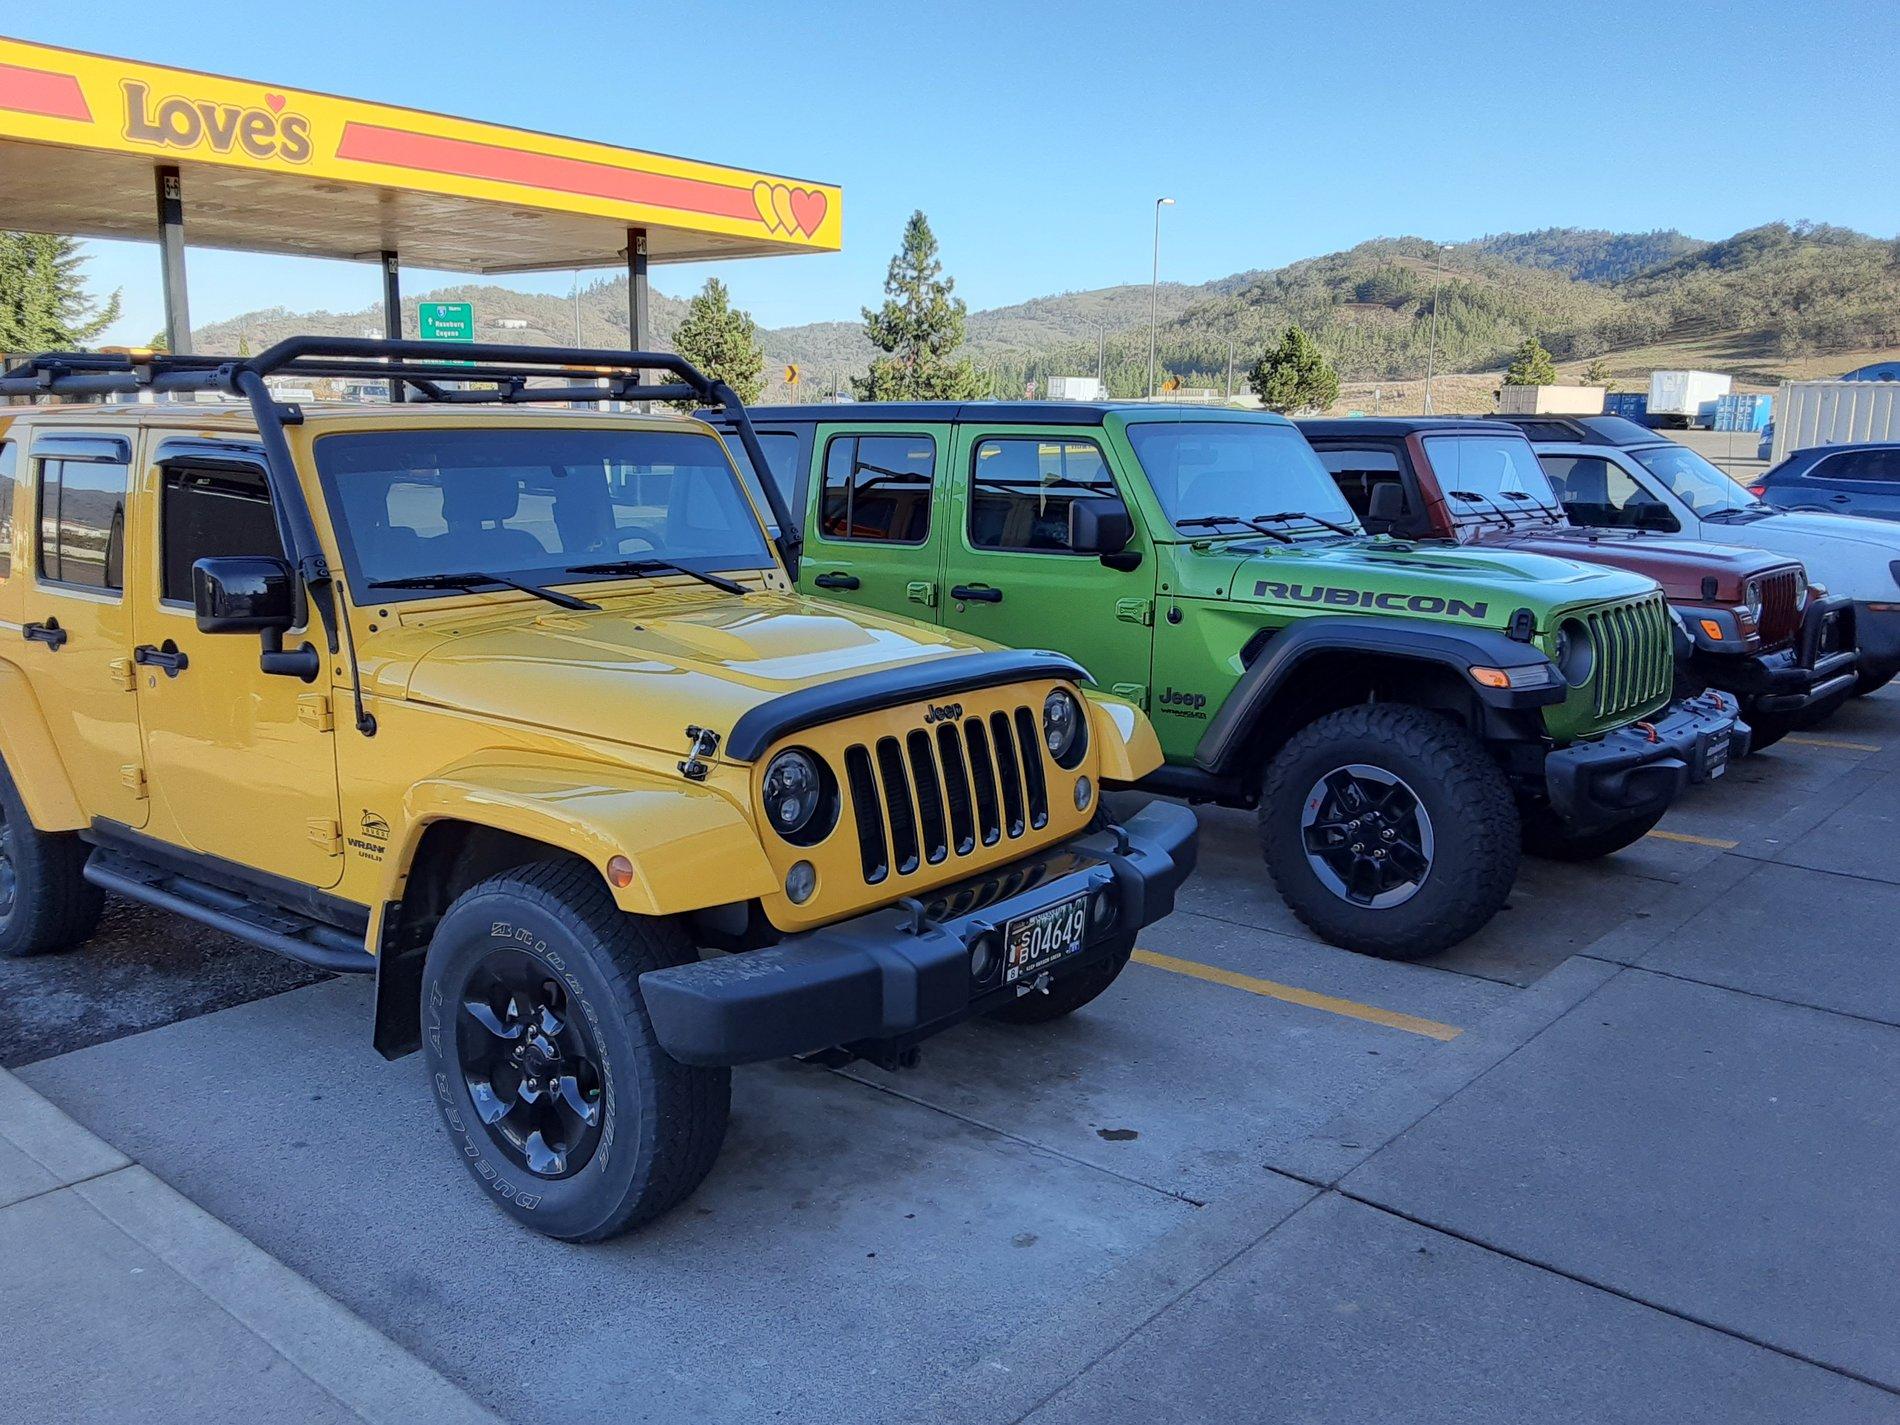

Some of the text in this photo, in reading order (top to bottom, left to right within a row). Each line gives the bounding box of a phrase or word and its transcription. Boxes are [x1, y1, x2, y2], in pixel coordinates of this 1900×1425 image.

[435, 320, 464, 329] Roseburg
[435, 329, 459, 338] Eugene
[1253, 580, 1489, 619] RUBICON
[1159, 687, 1207, 710] Jeep
[923, 702, 963, 724] Jeep
[1030, 909, 1084, 959] 04649
[426, 980, 542, 1211] DUELER A/T
